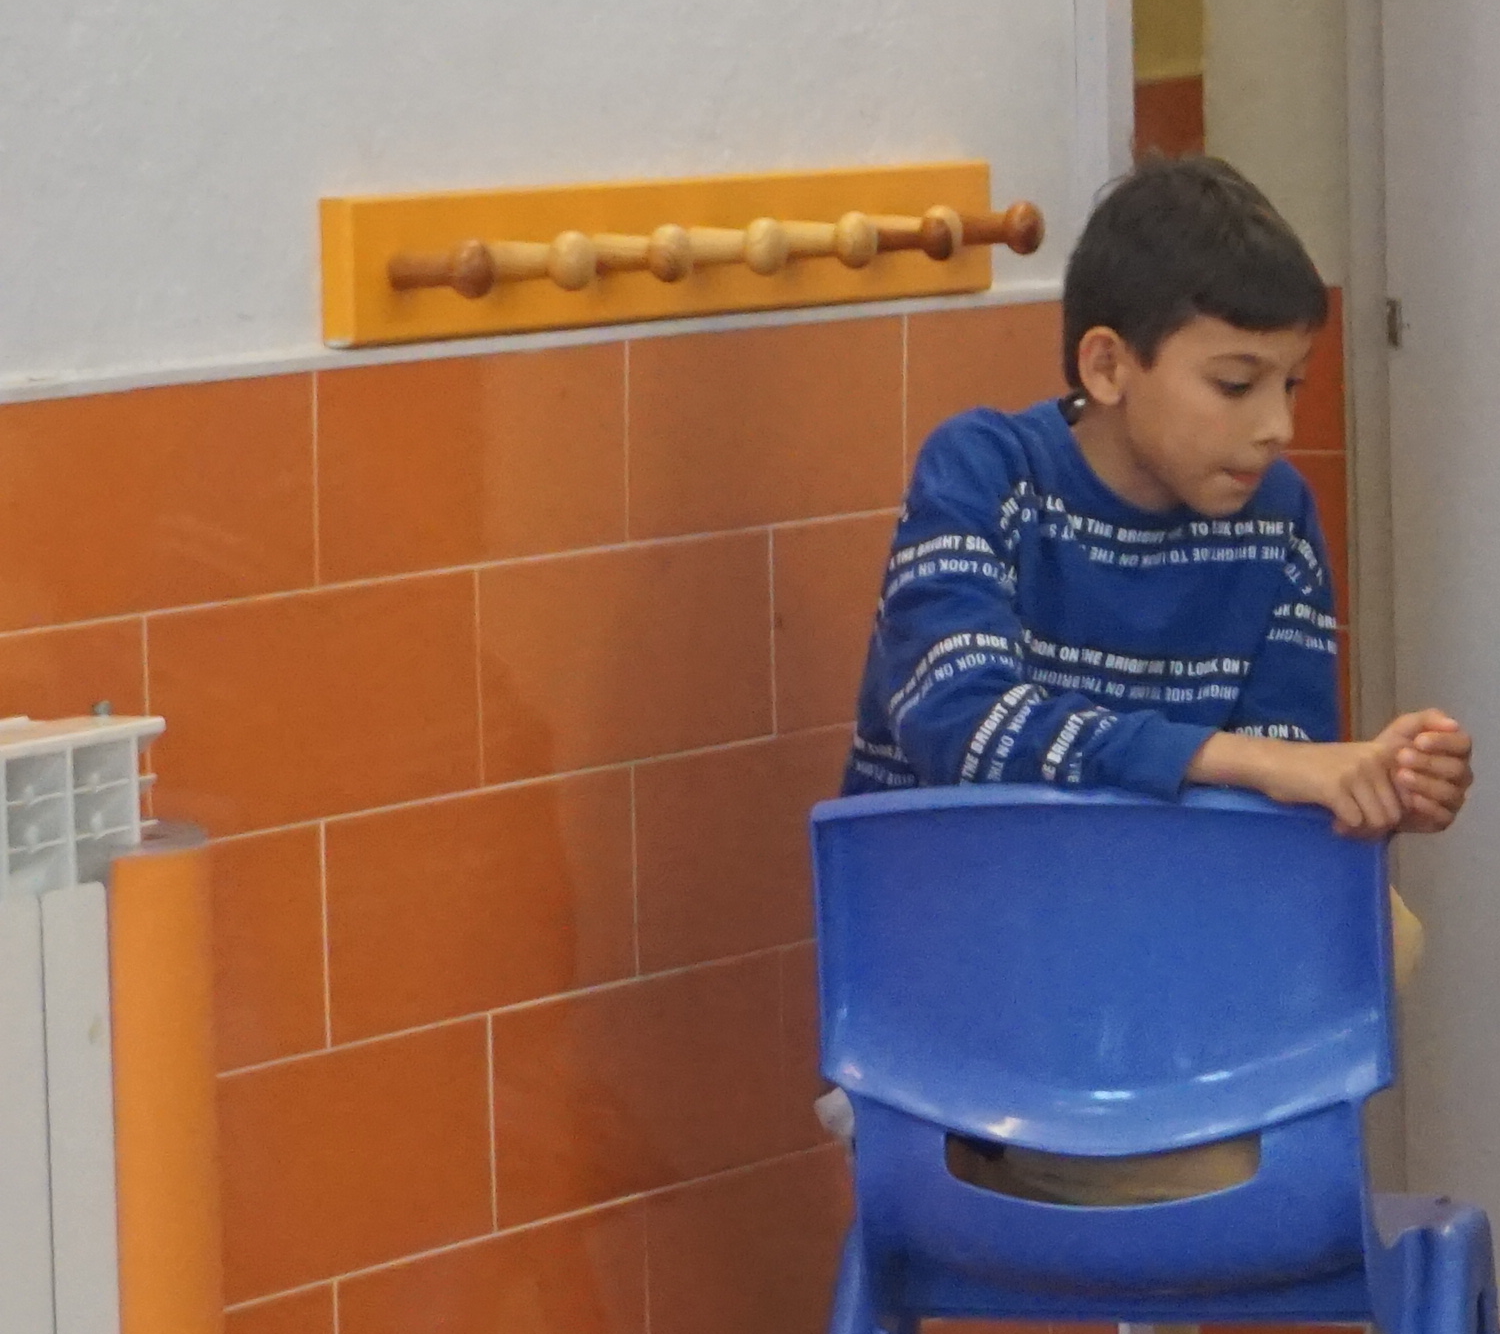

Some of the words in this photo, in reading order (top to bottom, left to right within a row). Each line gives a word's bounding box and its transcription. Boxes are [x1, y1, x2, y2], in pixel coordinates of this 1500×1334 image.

[1190, 521, 1208, 537] TO
[1258, 519, 1285, 536] THE
[976, 633, 1009, 651] SIDE
[1059, 646, 1079, 663] ON
[1222, 657, 1240, 674] ON
[1003, 683, 1033, 706] SID
